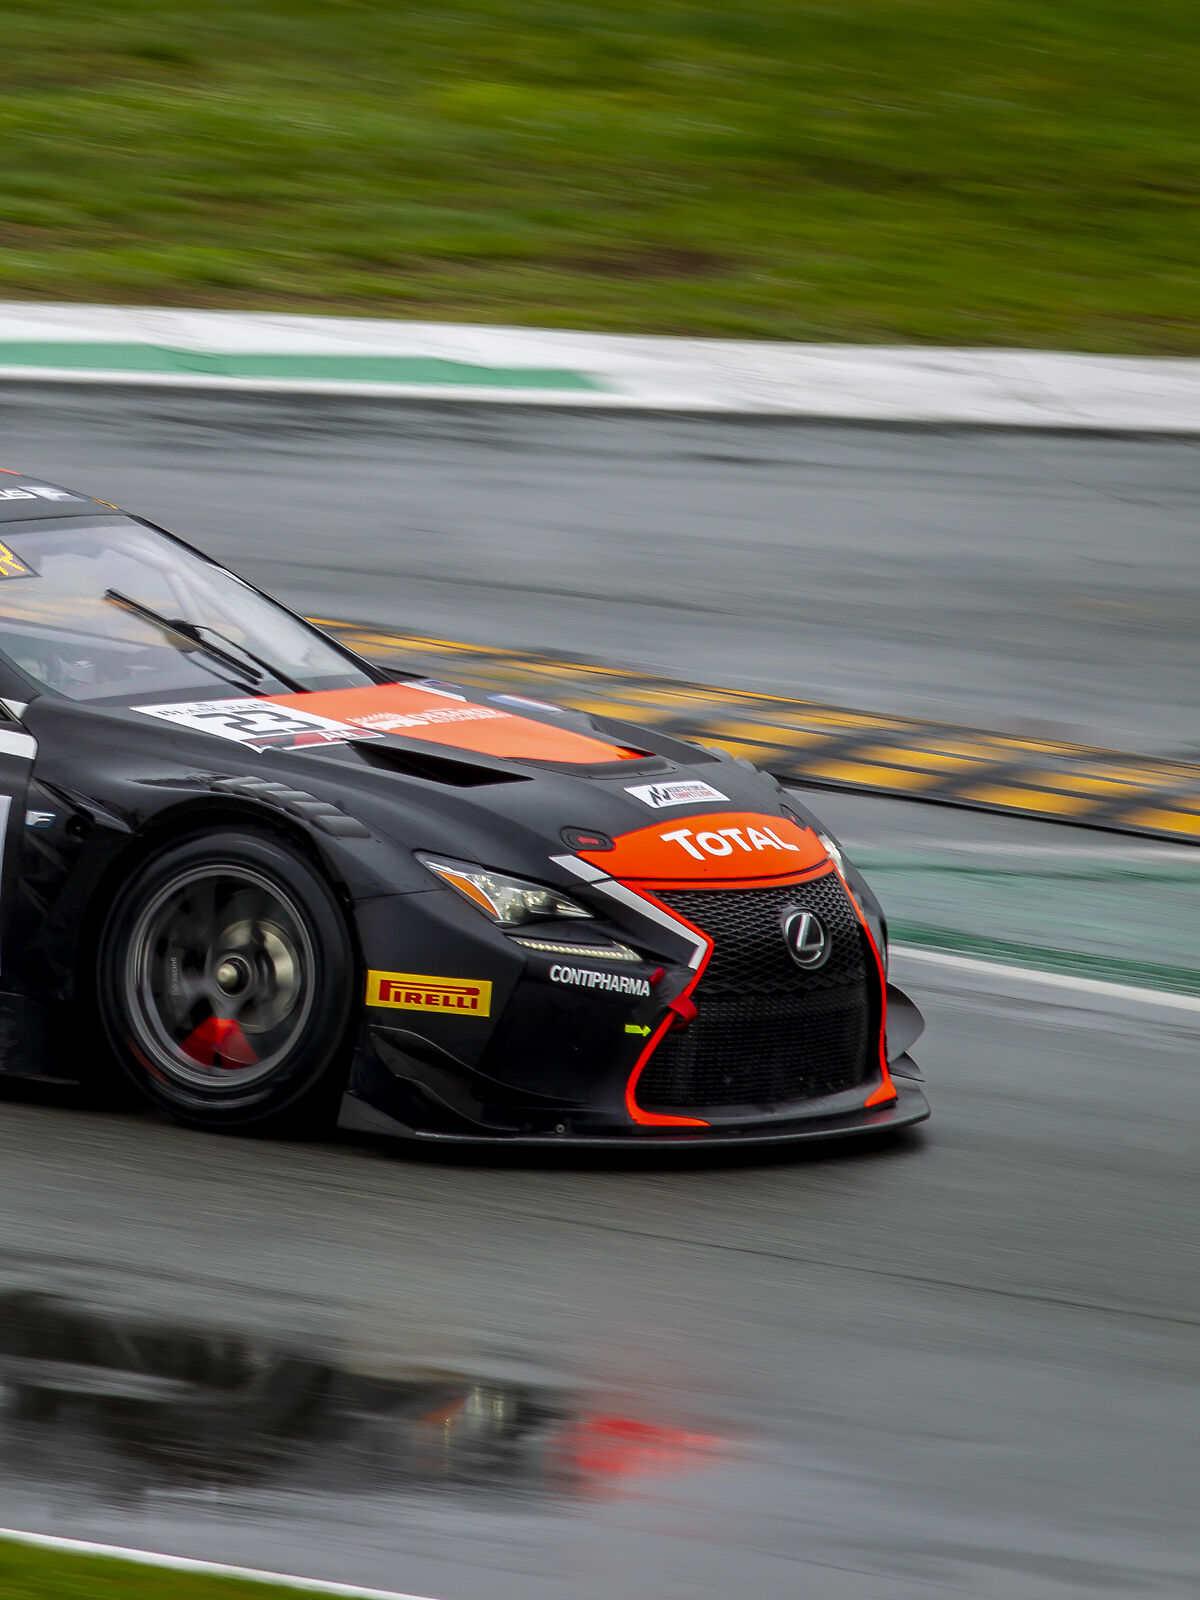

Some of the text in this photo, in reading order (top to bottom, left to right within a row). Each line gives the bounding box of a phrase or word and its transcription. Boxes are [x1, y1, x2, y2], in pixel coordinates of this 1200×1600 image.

[193, 710, 327, 736] 23
[660, 827, 800, 861] TOTAL
[379, 980, 481, 1010] PIRELLI
[550, 964, 650, 997] CONTIPHARMA
